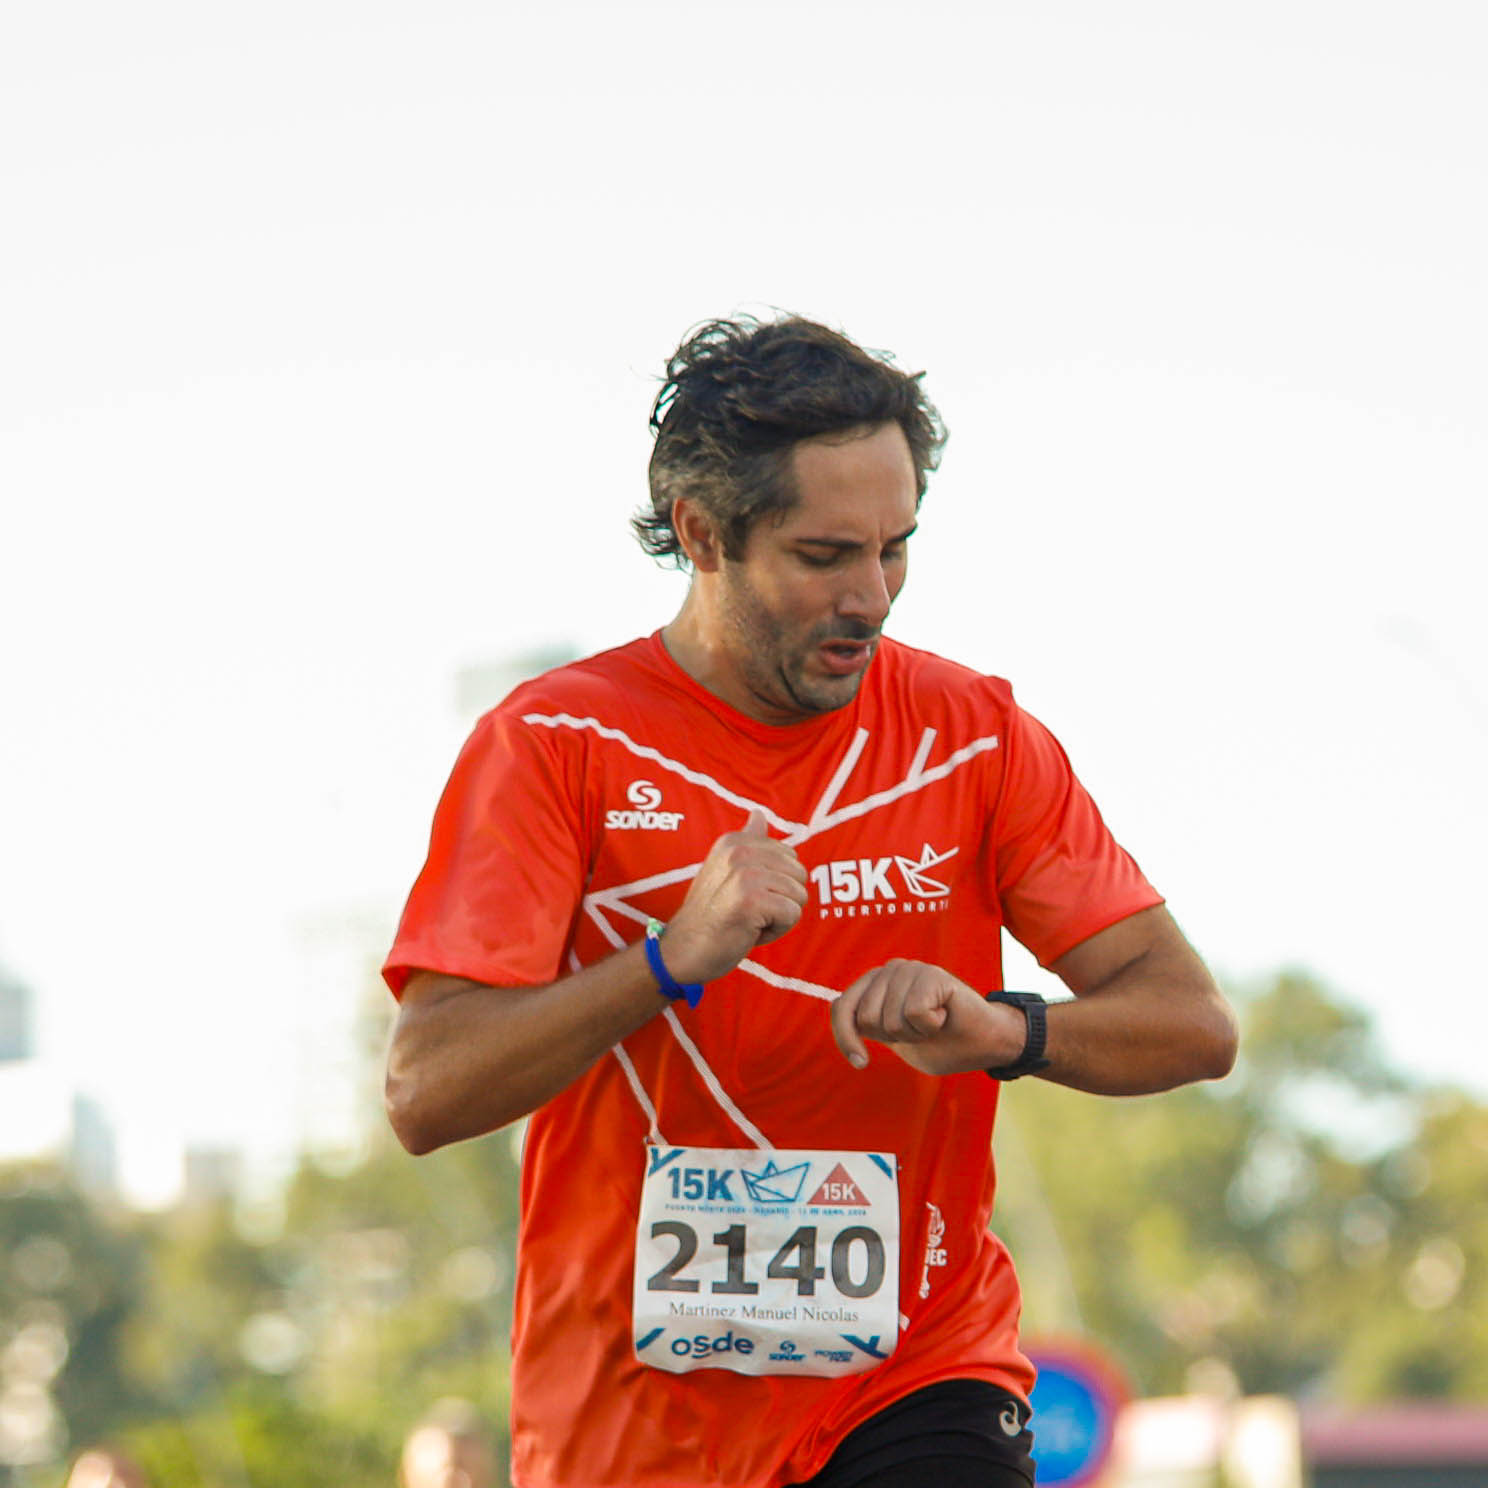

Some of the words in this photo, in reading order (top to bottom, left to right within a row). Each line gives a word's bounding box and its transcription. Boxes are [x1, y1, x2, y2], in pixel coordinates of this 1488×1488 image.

[810, 857, 896, 904] 15K
[820, 903, 896, 919] PUERTO
[903, 899, 949, 913] NORT
[668, 1167, 734, 1201] 15K
[822, 1182, 856, 1201] 15K
[647, 1220, 886, 1299] 2140
[669, 1301, 736, 1318] Martinez
[742, 1305, 798, 1321] Manuel
[803, 1306, 859, 1322] Nicolas
[671, 1331, 755, 1358] osde
